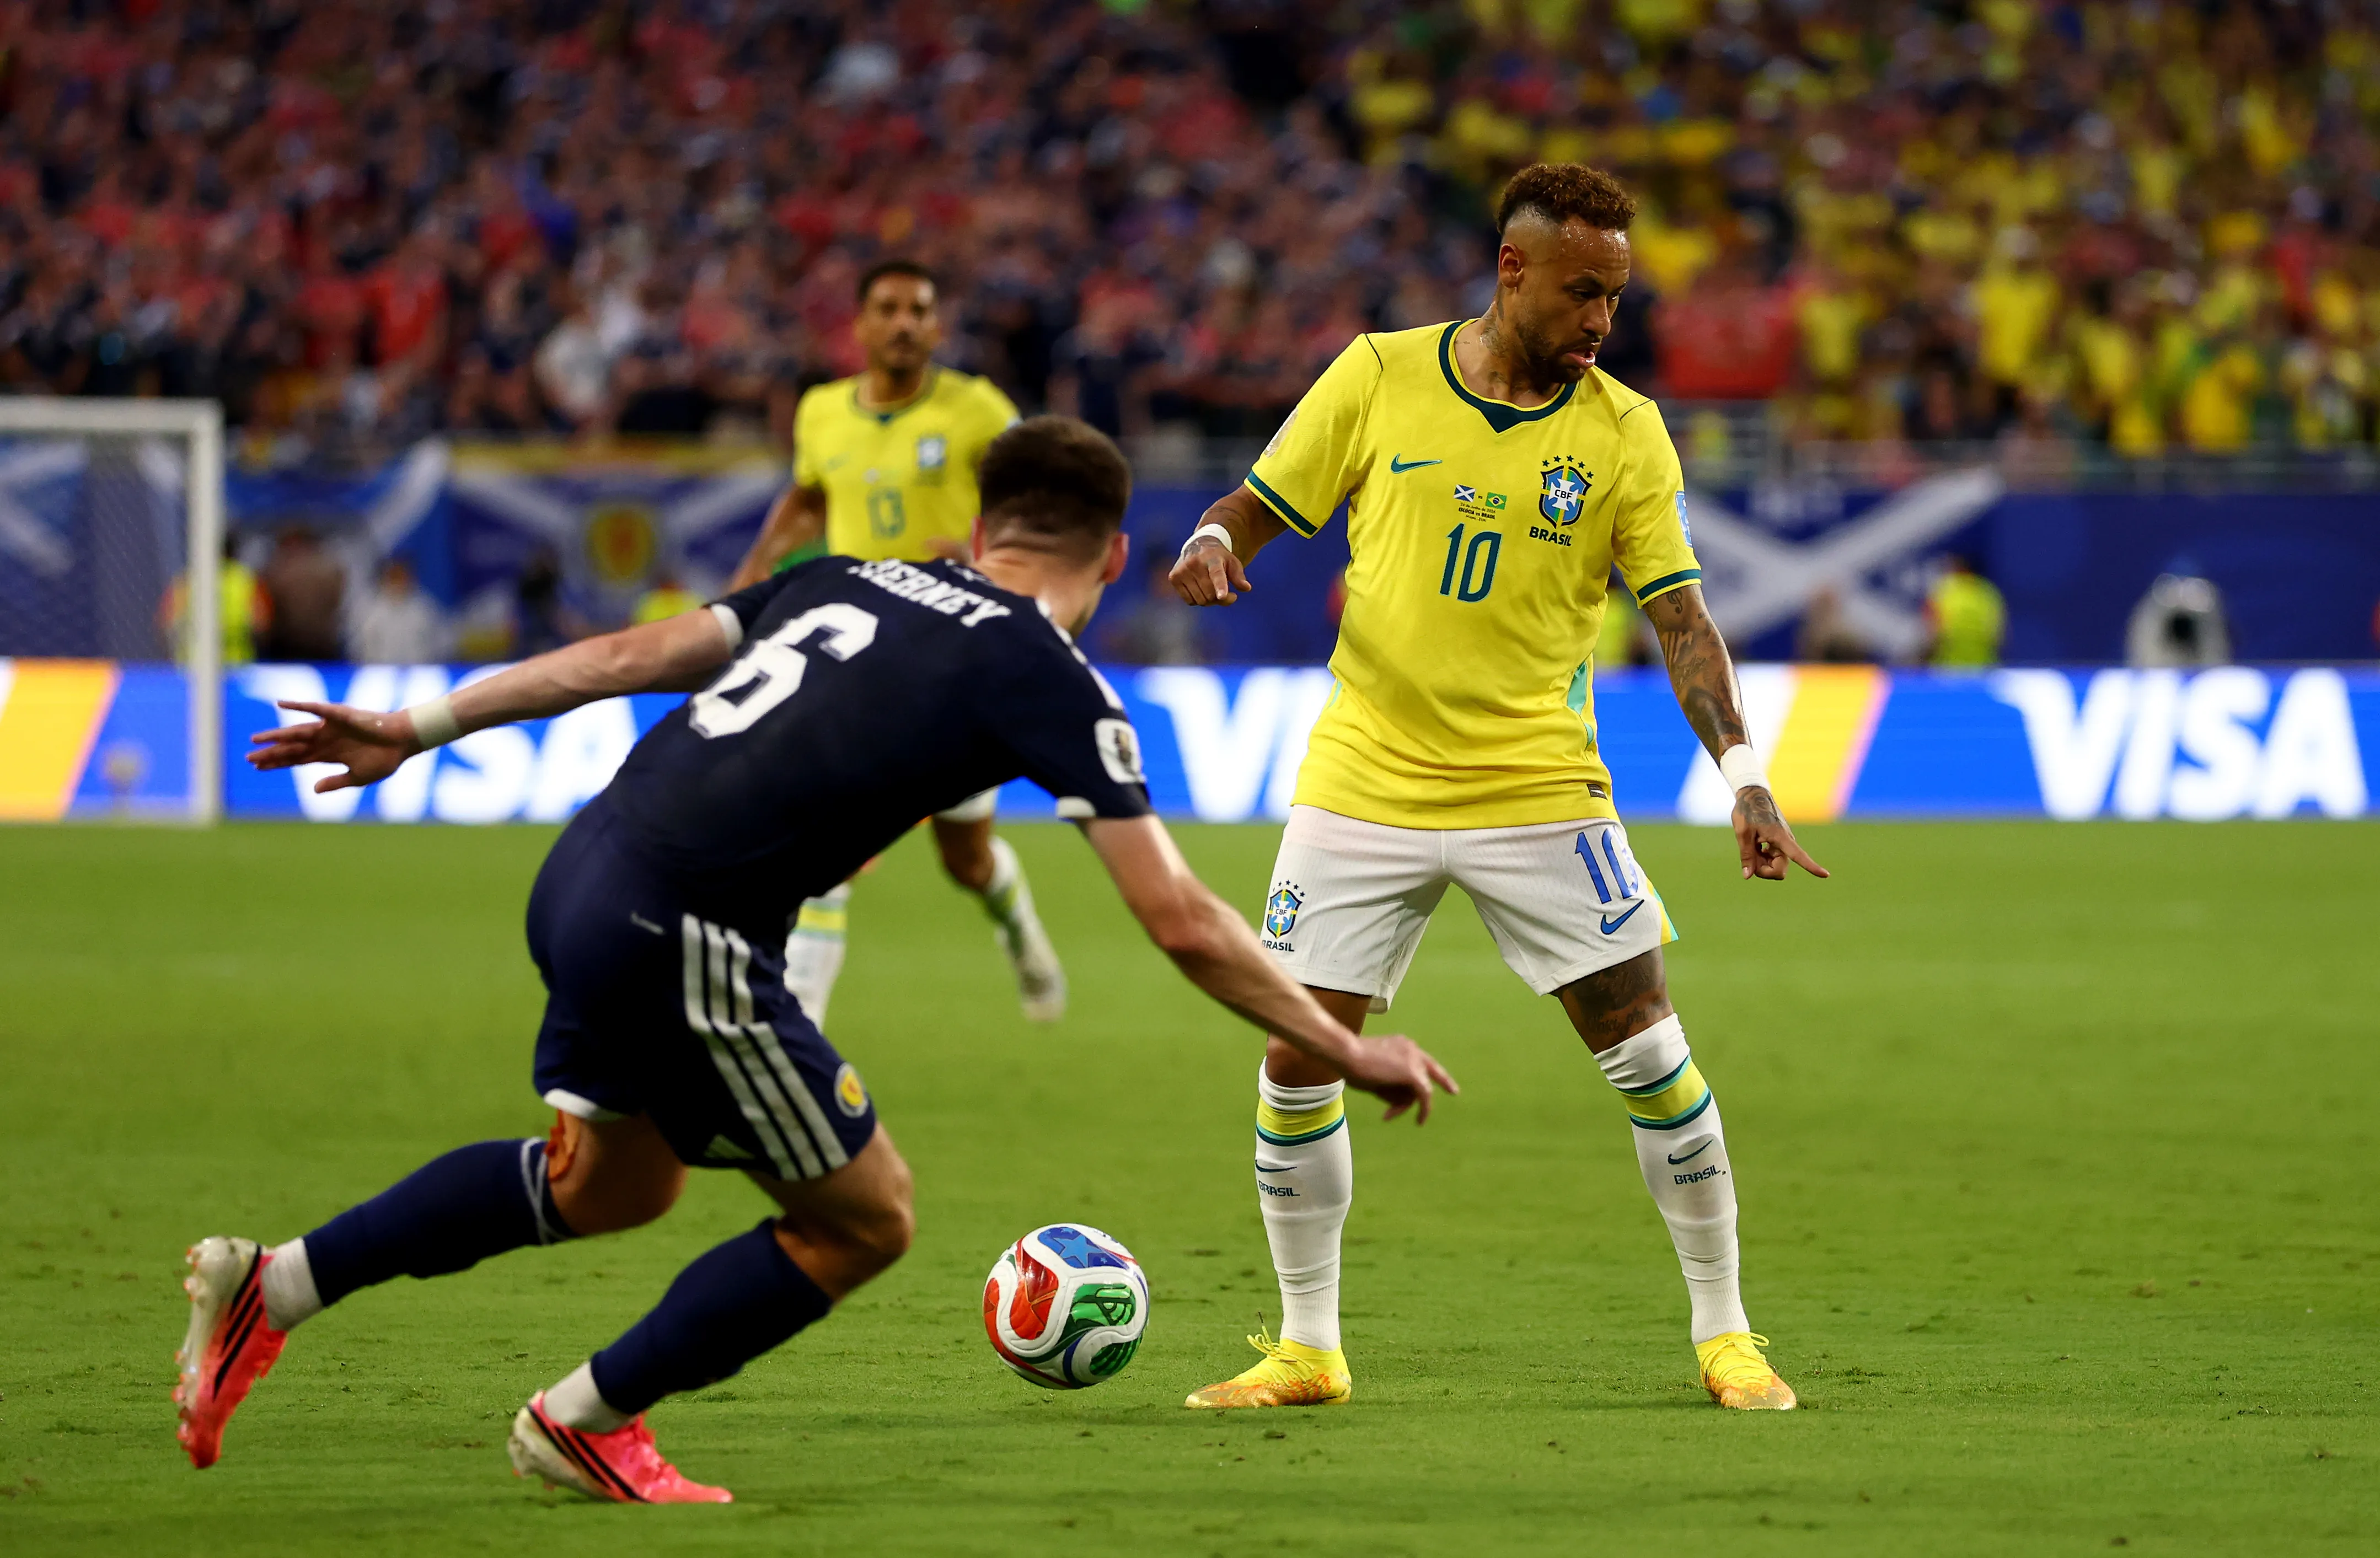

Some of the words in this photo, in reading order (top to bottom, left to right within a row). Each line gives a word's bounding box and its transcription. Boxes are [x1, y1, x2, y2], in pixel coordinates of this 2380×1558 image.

[1554, 489, 1573, 499] CBF
[1529, 526, 1572, 546] BRASIL
[1439, 522, 1502, 602] 10
[688, 603, 879, 739] 6
[1987, 666, 2369, 821] VISA
[1575, 825, 1639, 904] 10
[1258, 1180, 1300, 1197] BRASIL
[1674, 1164, 1721, 1185] BRASIL
